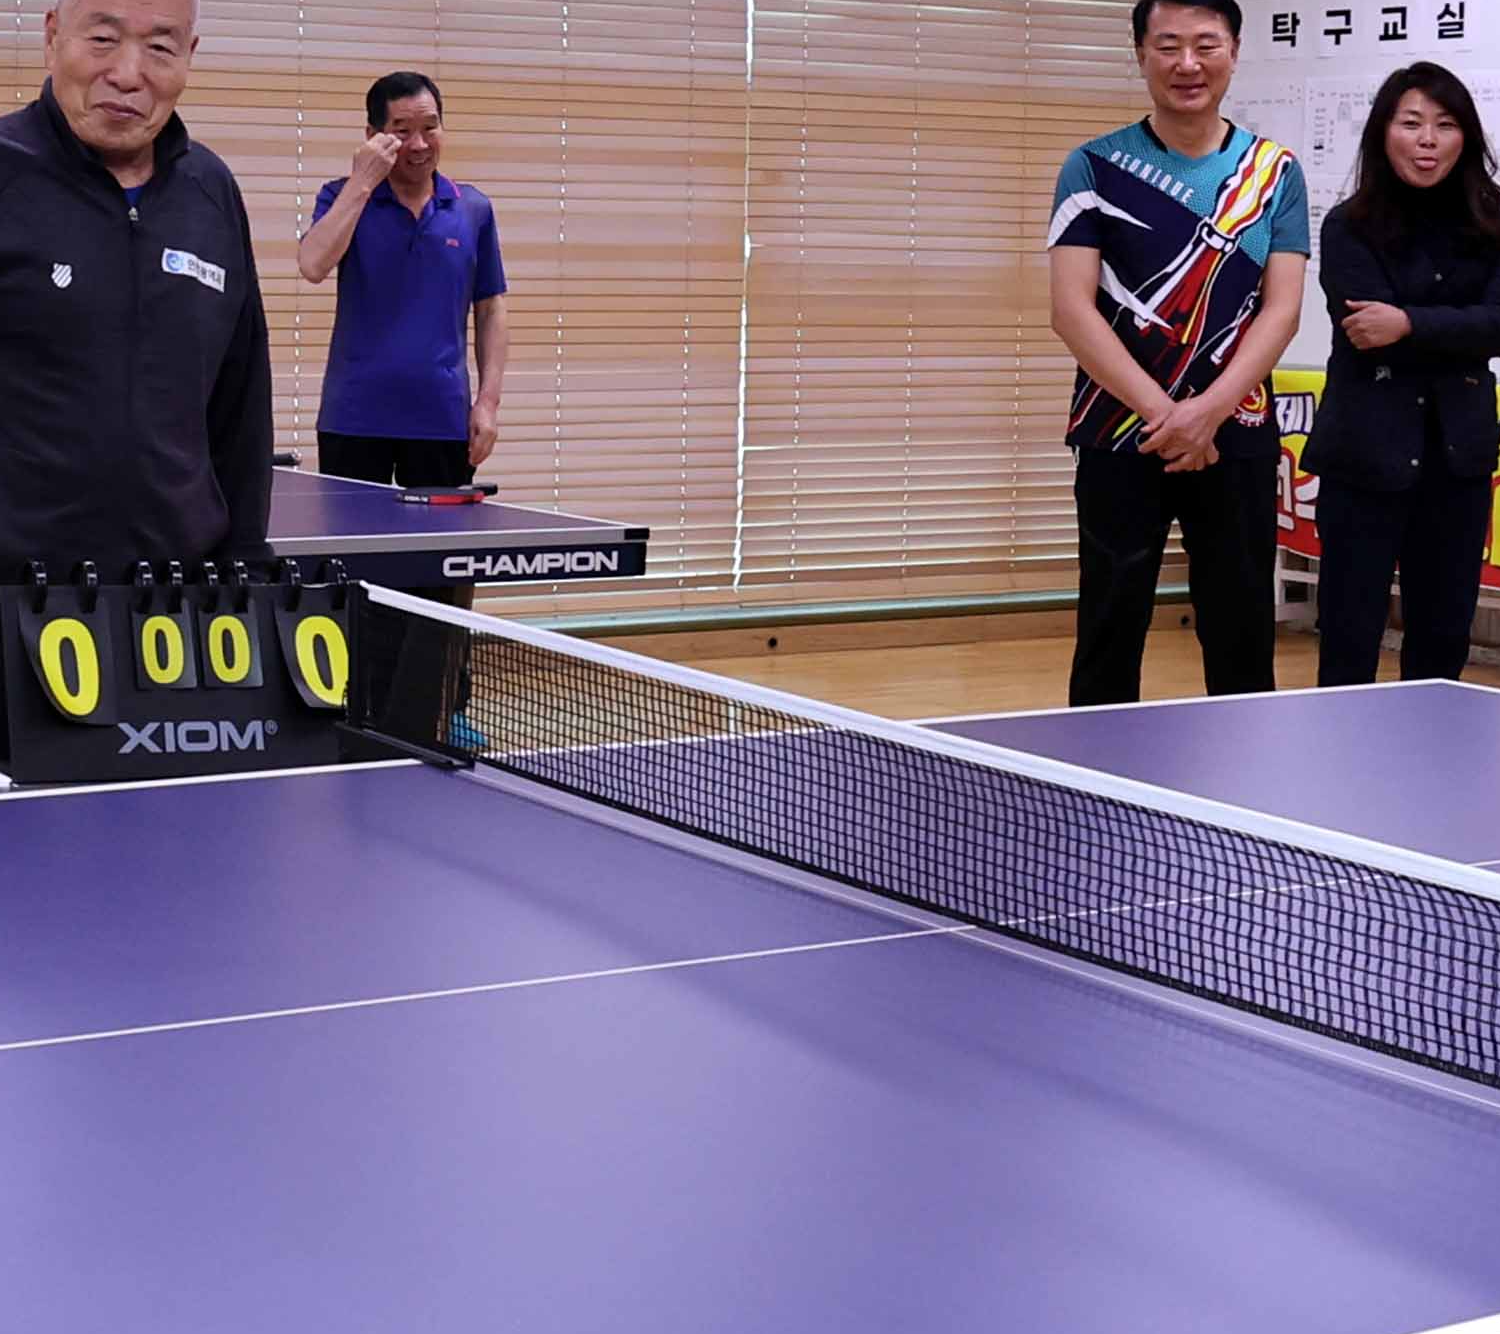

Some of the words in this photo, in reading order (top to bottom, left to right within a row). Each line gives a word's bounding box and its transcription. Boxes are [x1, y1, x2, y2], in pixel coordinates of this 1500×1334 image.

[442, 550, 619, 579] CHAMPION
[39, 617, 100, 716] 0
[295, 615, 349, 708] 0
